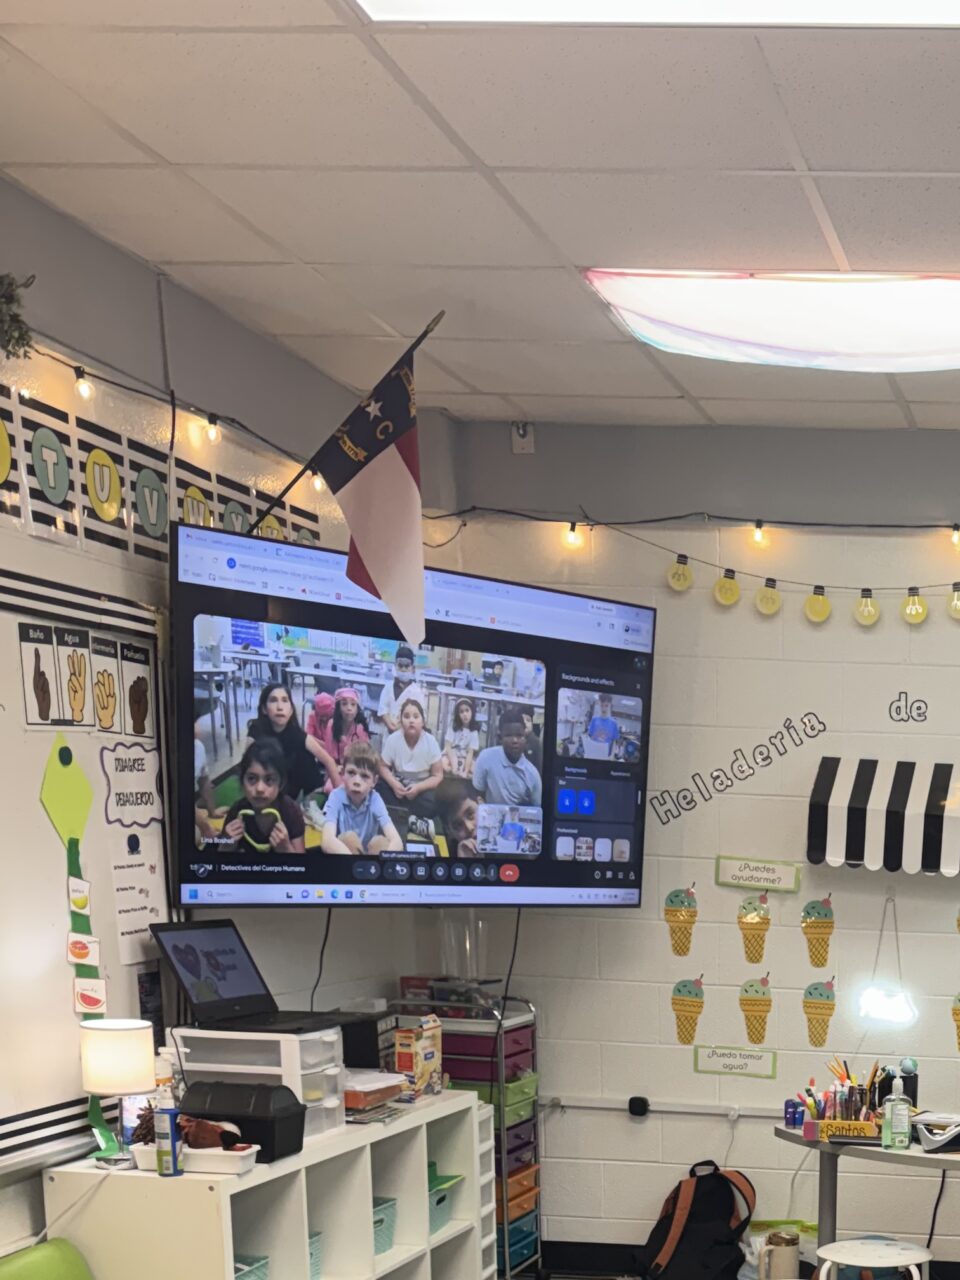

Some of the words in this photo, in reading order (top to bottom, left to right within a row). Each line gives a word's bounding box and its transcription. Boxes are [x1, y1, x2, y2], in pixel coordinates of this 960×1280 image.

[41, 445, 59, 490] T
[93, 463, 111, 503] U
[142, 486, 159, 526] V
[29, 629, 45, 640] Baño
[64, 633, 80, 645] Agua
[889, 692, 928, 722] de
[650, 712, 826, 825] Heladería
[221, 864, 251, 872] Detectives
[252, 864, 261, 872] del
[262, 864, 282, 874] Cuerpo
[282, 865, 305, 873] Humano
[738, 863, 776, 874] ¿Puedes
[731, 874, 782, 885] ayudarme?
[707, 1050, 737, 1059] ¿Puedo
[722, 1063, 748, 1071] agua?
[826, 1124, 867, 1137] Santos
